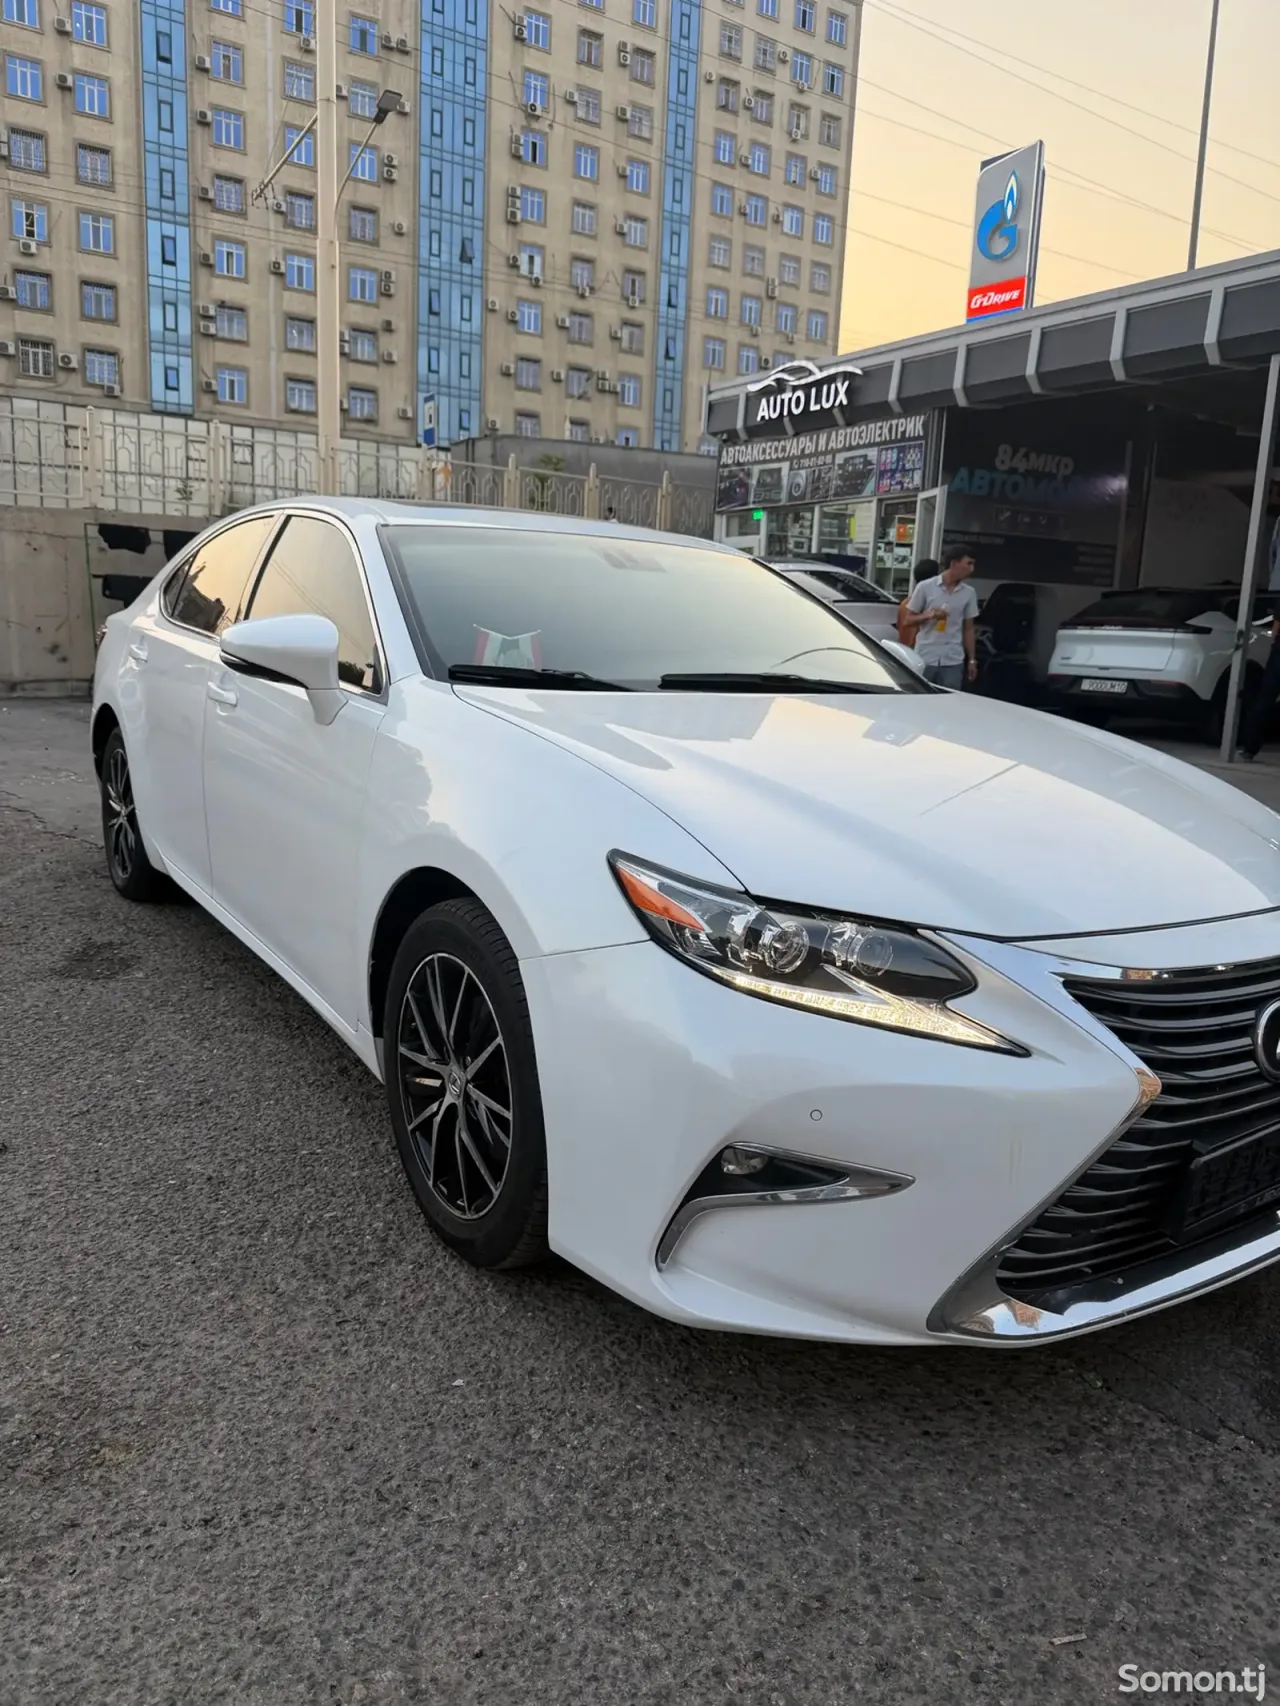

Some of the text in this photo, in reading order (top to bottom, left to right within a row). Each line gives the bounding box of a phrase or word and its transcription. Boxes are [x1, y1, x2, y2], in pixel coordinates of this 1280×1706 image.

[756, 380, 850, 421] AUTO LUX
[720, 415, 925, 465] АВТОАКСЕССУАРЫ И АВТОЭЛЕКТРИК
